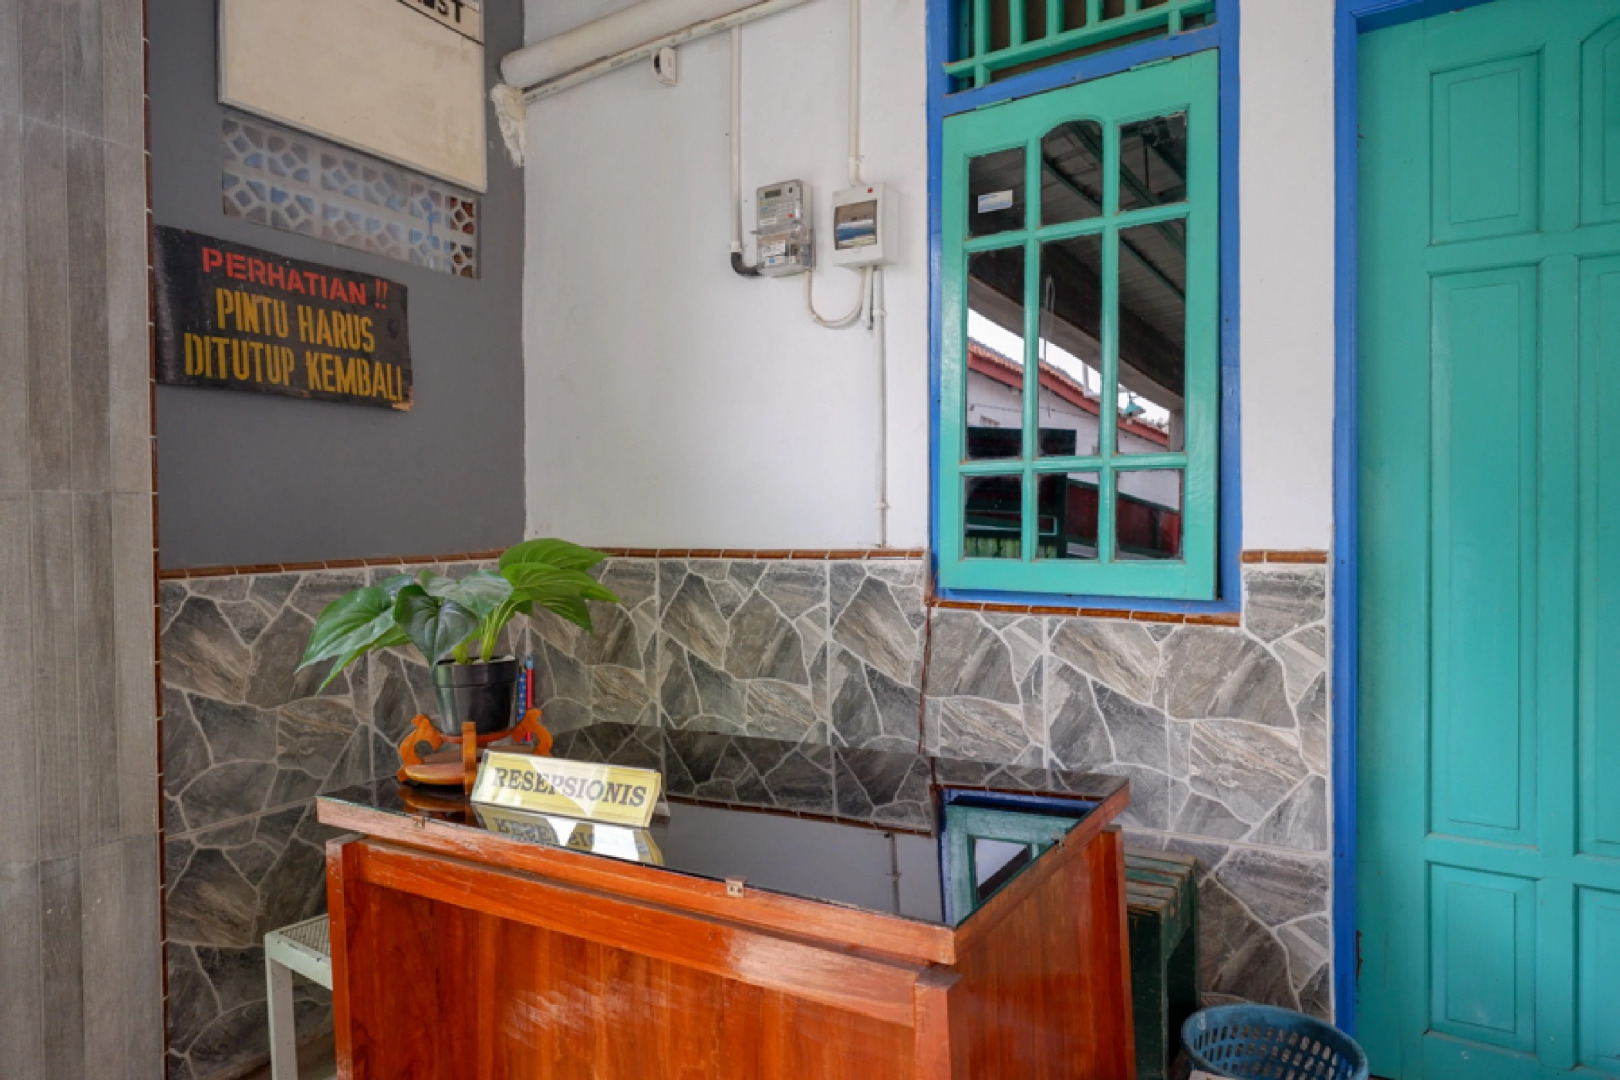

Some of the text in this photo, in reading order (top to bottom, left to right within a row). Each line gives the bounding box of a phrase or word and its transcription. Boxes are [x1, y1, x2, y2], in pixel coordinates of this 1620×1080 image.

[202, 246, 388, 310] PERHATIAN !!
[215, 287, 376, 353] PINTU HARUS
[183, 332, 402, 401] DITUTUP KEMBALI
[493, 766, 647, 807] RESEPSIONIS
